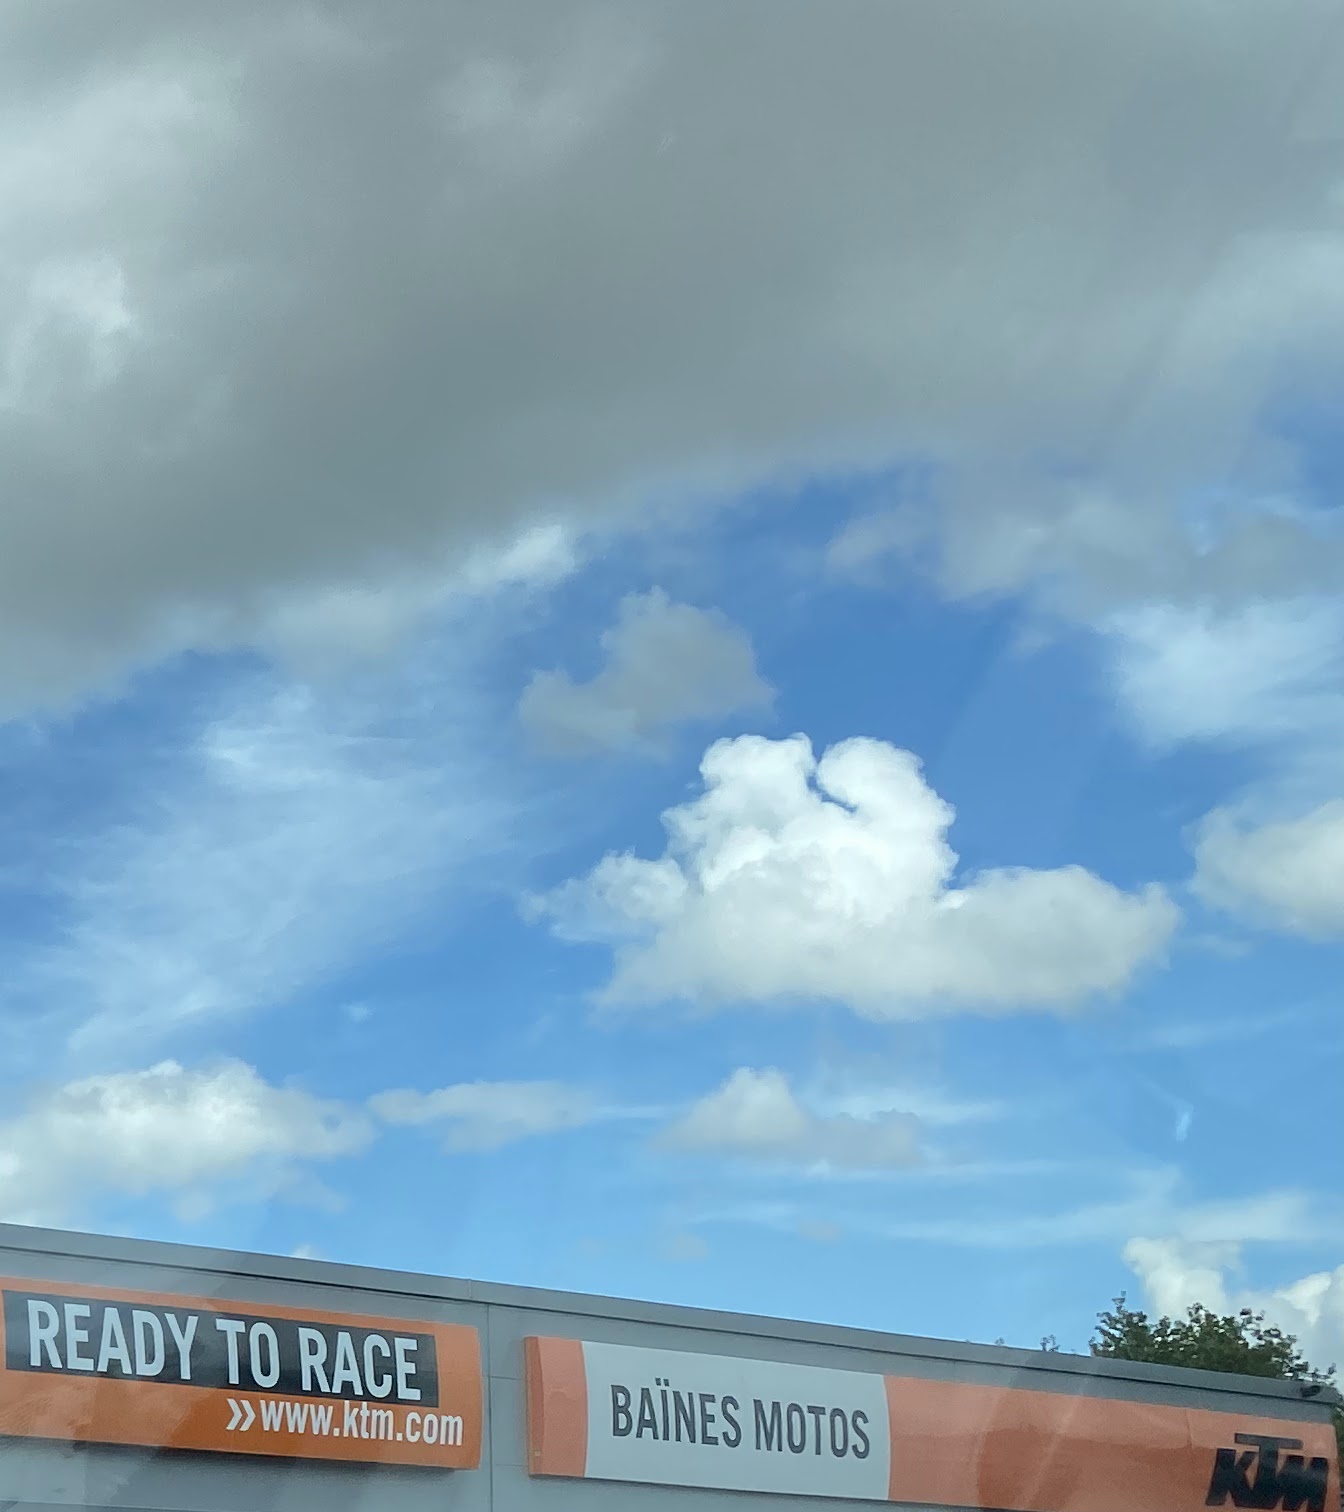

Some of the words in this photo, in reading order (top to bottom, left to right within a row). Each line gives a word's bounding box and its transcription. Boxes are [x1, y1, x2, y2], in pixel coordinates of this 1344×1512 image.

[26, 1298, 200, 1381] READY
[215, 1318, 281, 1389] TO
[297, 1326, 422, 1401] RACE
[259, 1400, 464, 1447] www.ktm.com
[610, 1376, 743, 1449] BAÏNES
[752, 1398, 871, 1460] MOTOS
